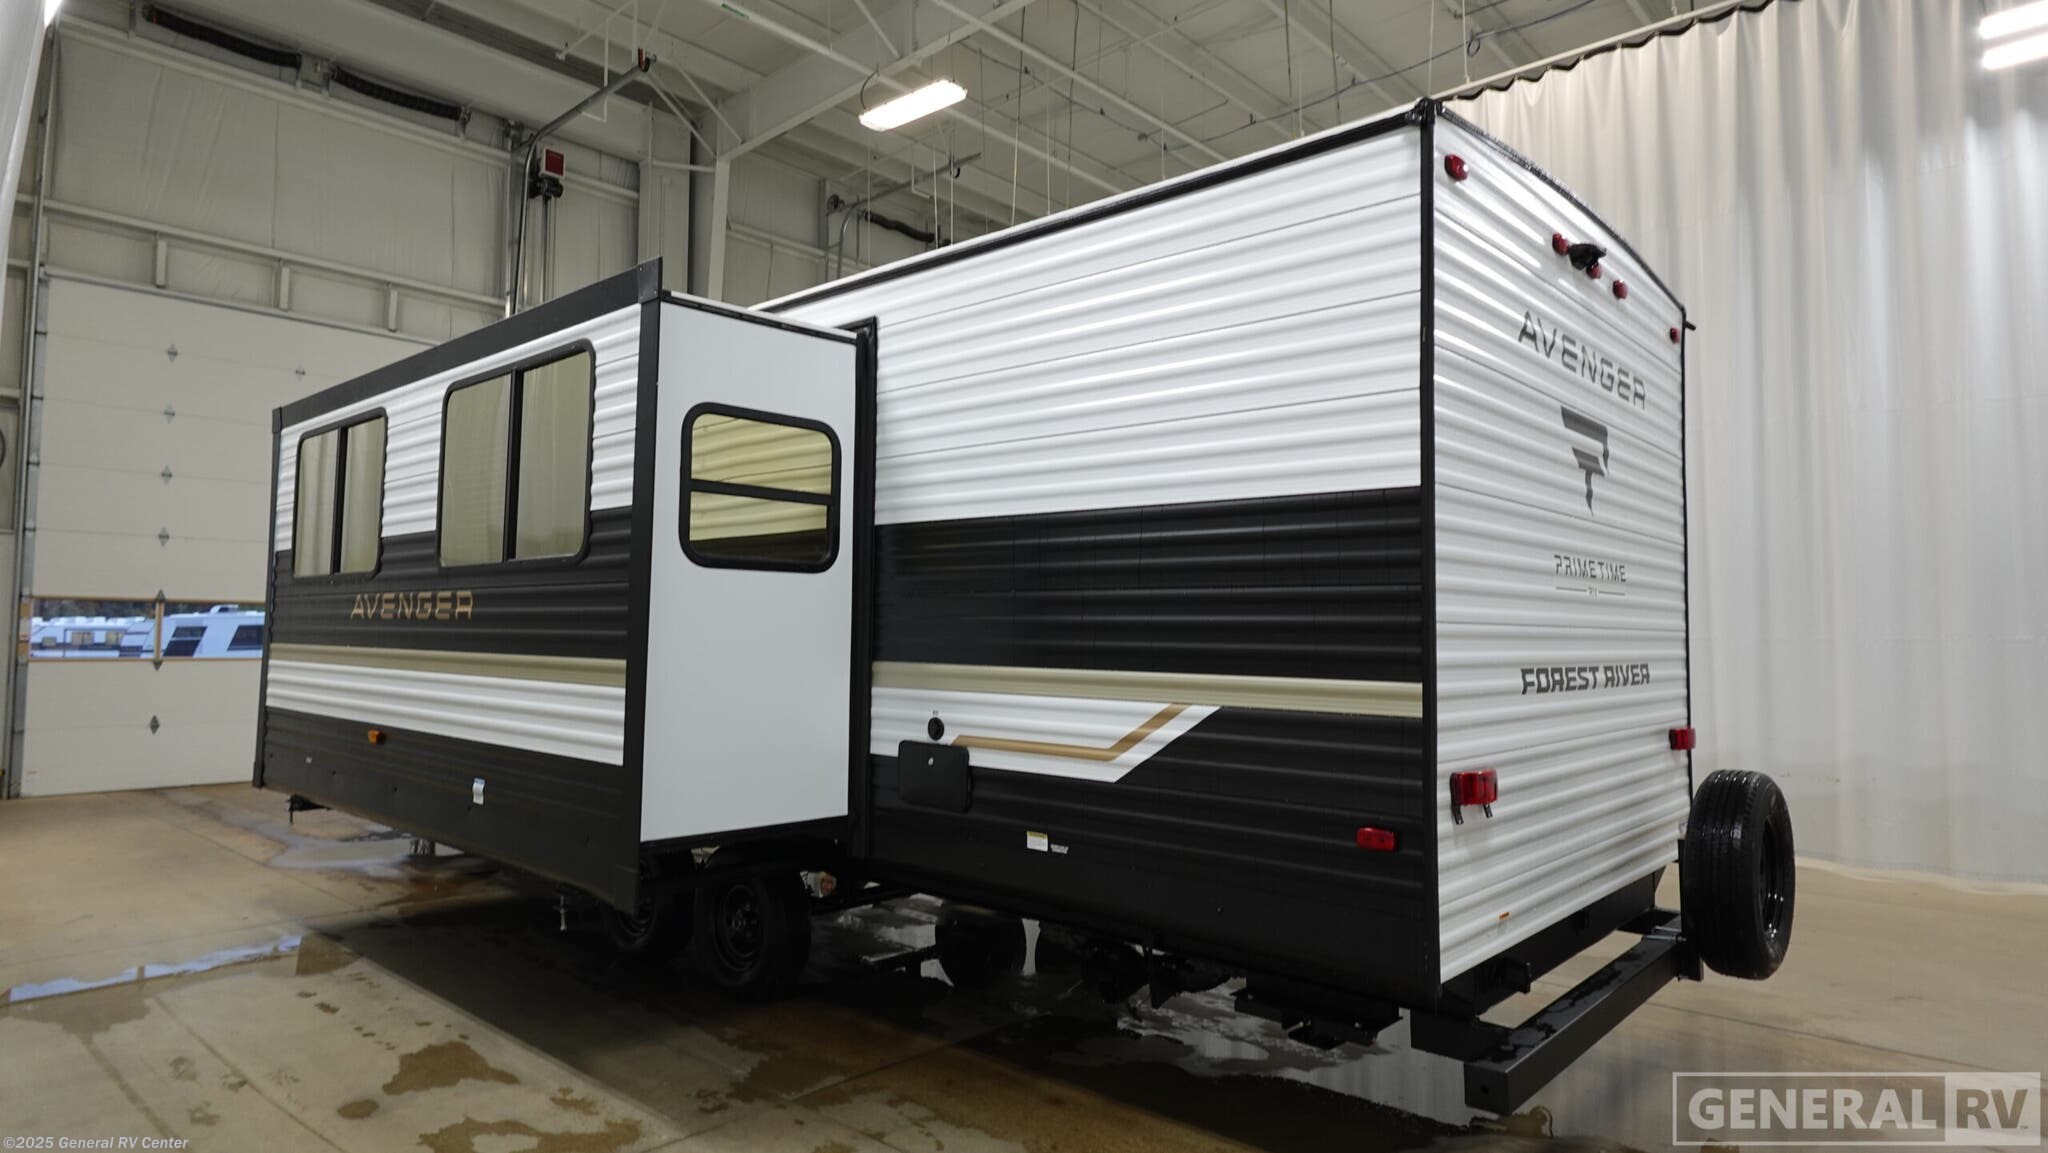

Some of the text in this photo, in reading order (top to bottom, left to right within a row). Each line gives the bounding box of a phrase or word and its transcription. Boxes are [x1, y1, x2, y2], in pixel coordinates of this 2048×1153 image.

[1518, 310, 1646, 411] AVENGER
[351, 590, 474, 621] AVENGER
[1520, 663, 1651, 695] FOREST RIVER
